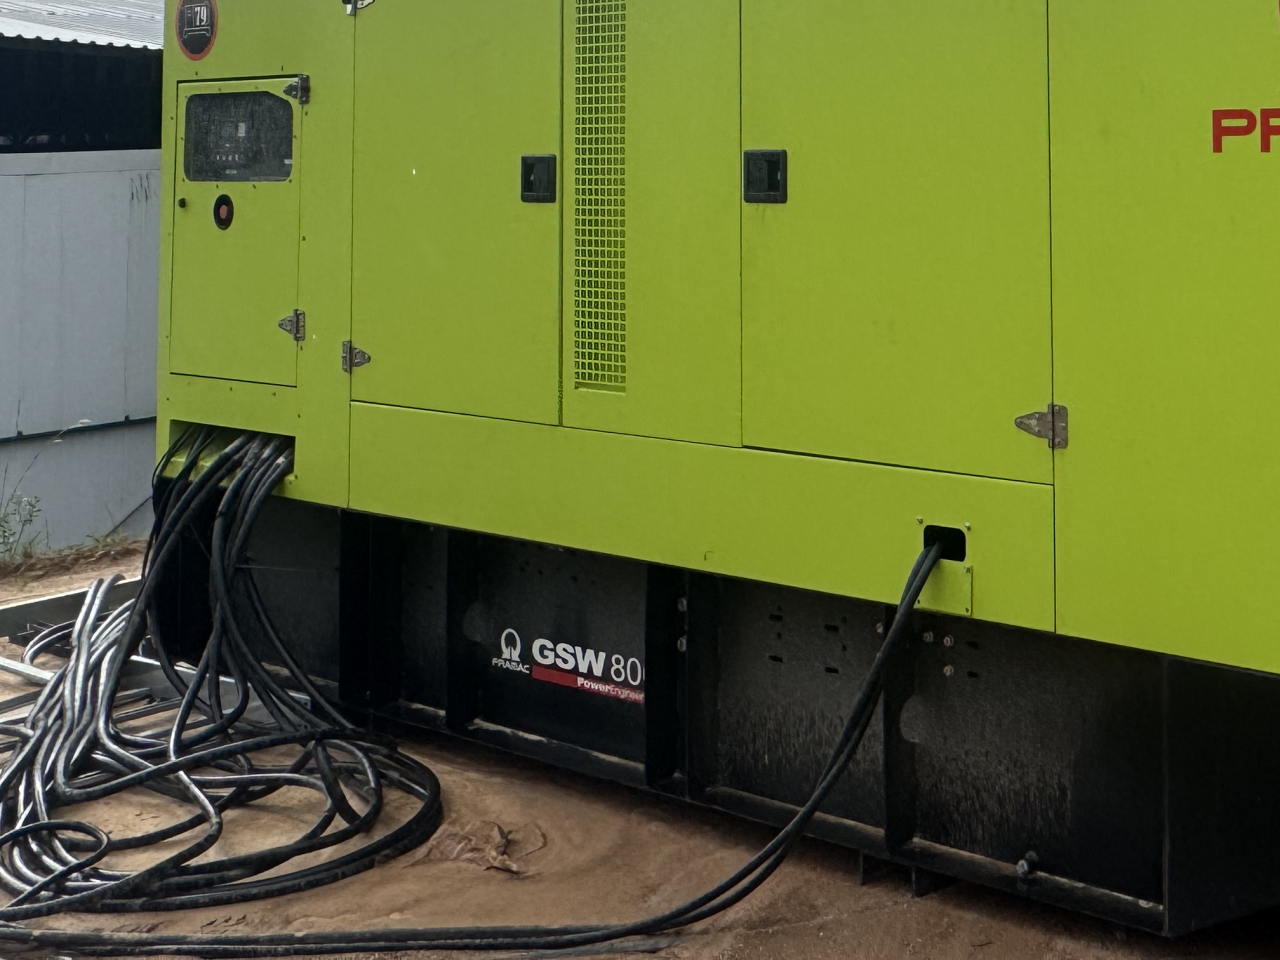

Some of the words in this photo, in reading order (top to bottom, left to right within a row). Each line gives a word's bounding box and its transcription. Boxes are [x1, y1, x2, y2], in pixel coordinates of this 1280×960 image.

[194, 6, 207, 26] 79
[532, 638, 606, 677] GSW
[610, 654, 645, 686] 80
